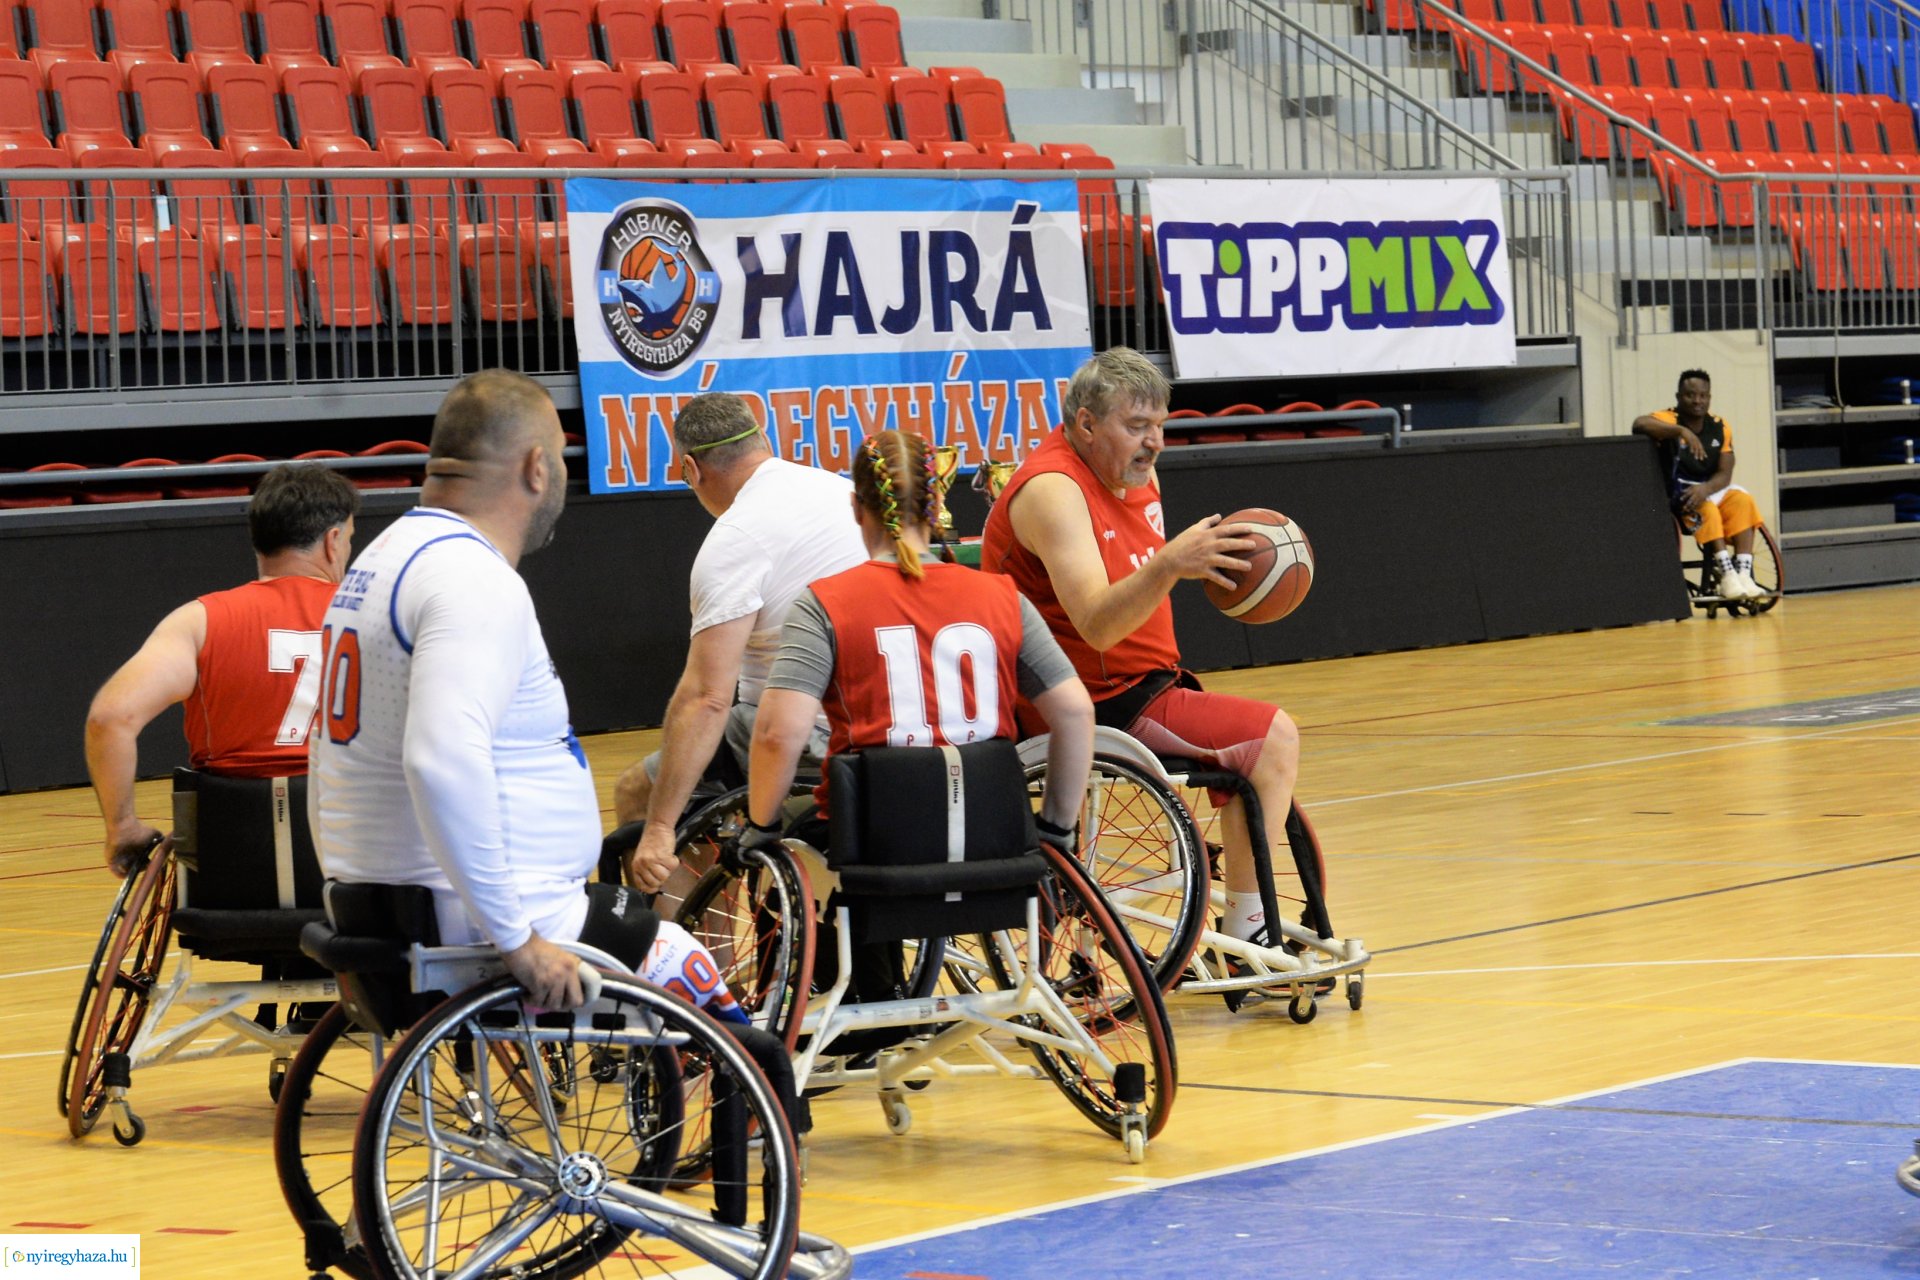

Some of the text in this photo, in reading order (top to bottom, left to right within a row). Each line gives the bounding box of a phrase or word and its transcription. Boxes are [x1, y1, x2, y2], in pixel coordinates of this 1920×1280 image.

[603, 277, 618, 297] H
[698, 278, 713, 297] H
[737, 201, 1053, 340] HAJRÁ
[688, 306, 708, 333] BS
[268, 629, 324, 746] 7
[874, 622, 999, 746] 10
[1166, 789, 1192, 825] KENDA
